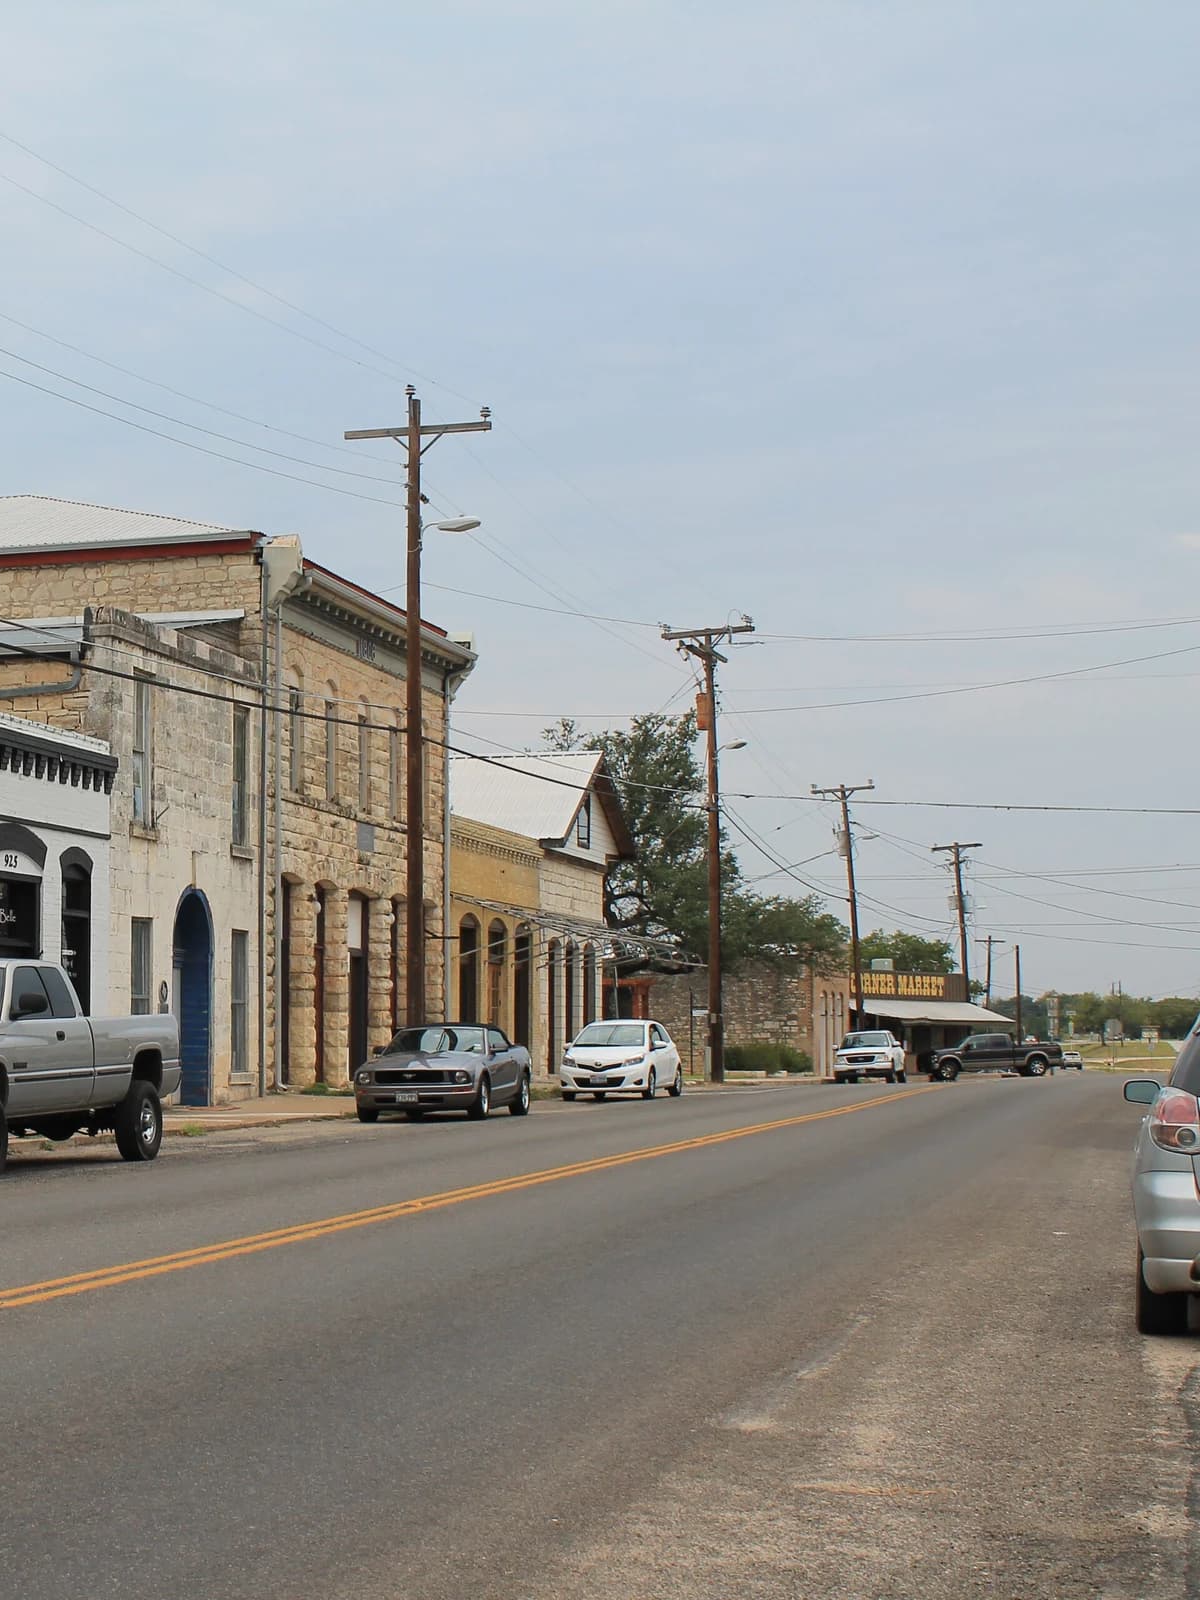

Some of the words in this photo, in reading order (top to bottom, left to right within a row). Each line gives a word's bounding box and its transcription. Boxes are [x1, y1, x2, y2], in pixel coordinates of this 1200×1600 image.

[4, 853, 18, 869] 925
[0, 908, 17, 924] Belle
[850, 972, 895, 994] CRNER
[897, 974, 945, 997] MARKET
